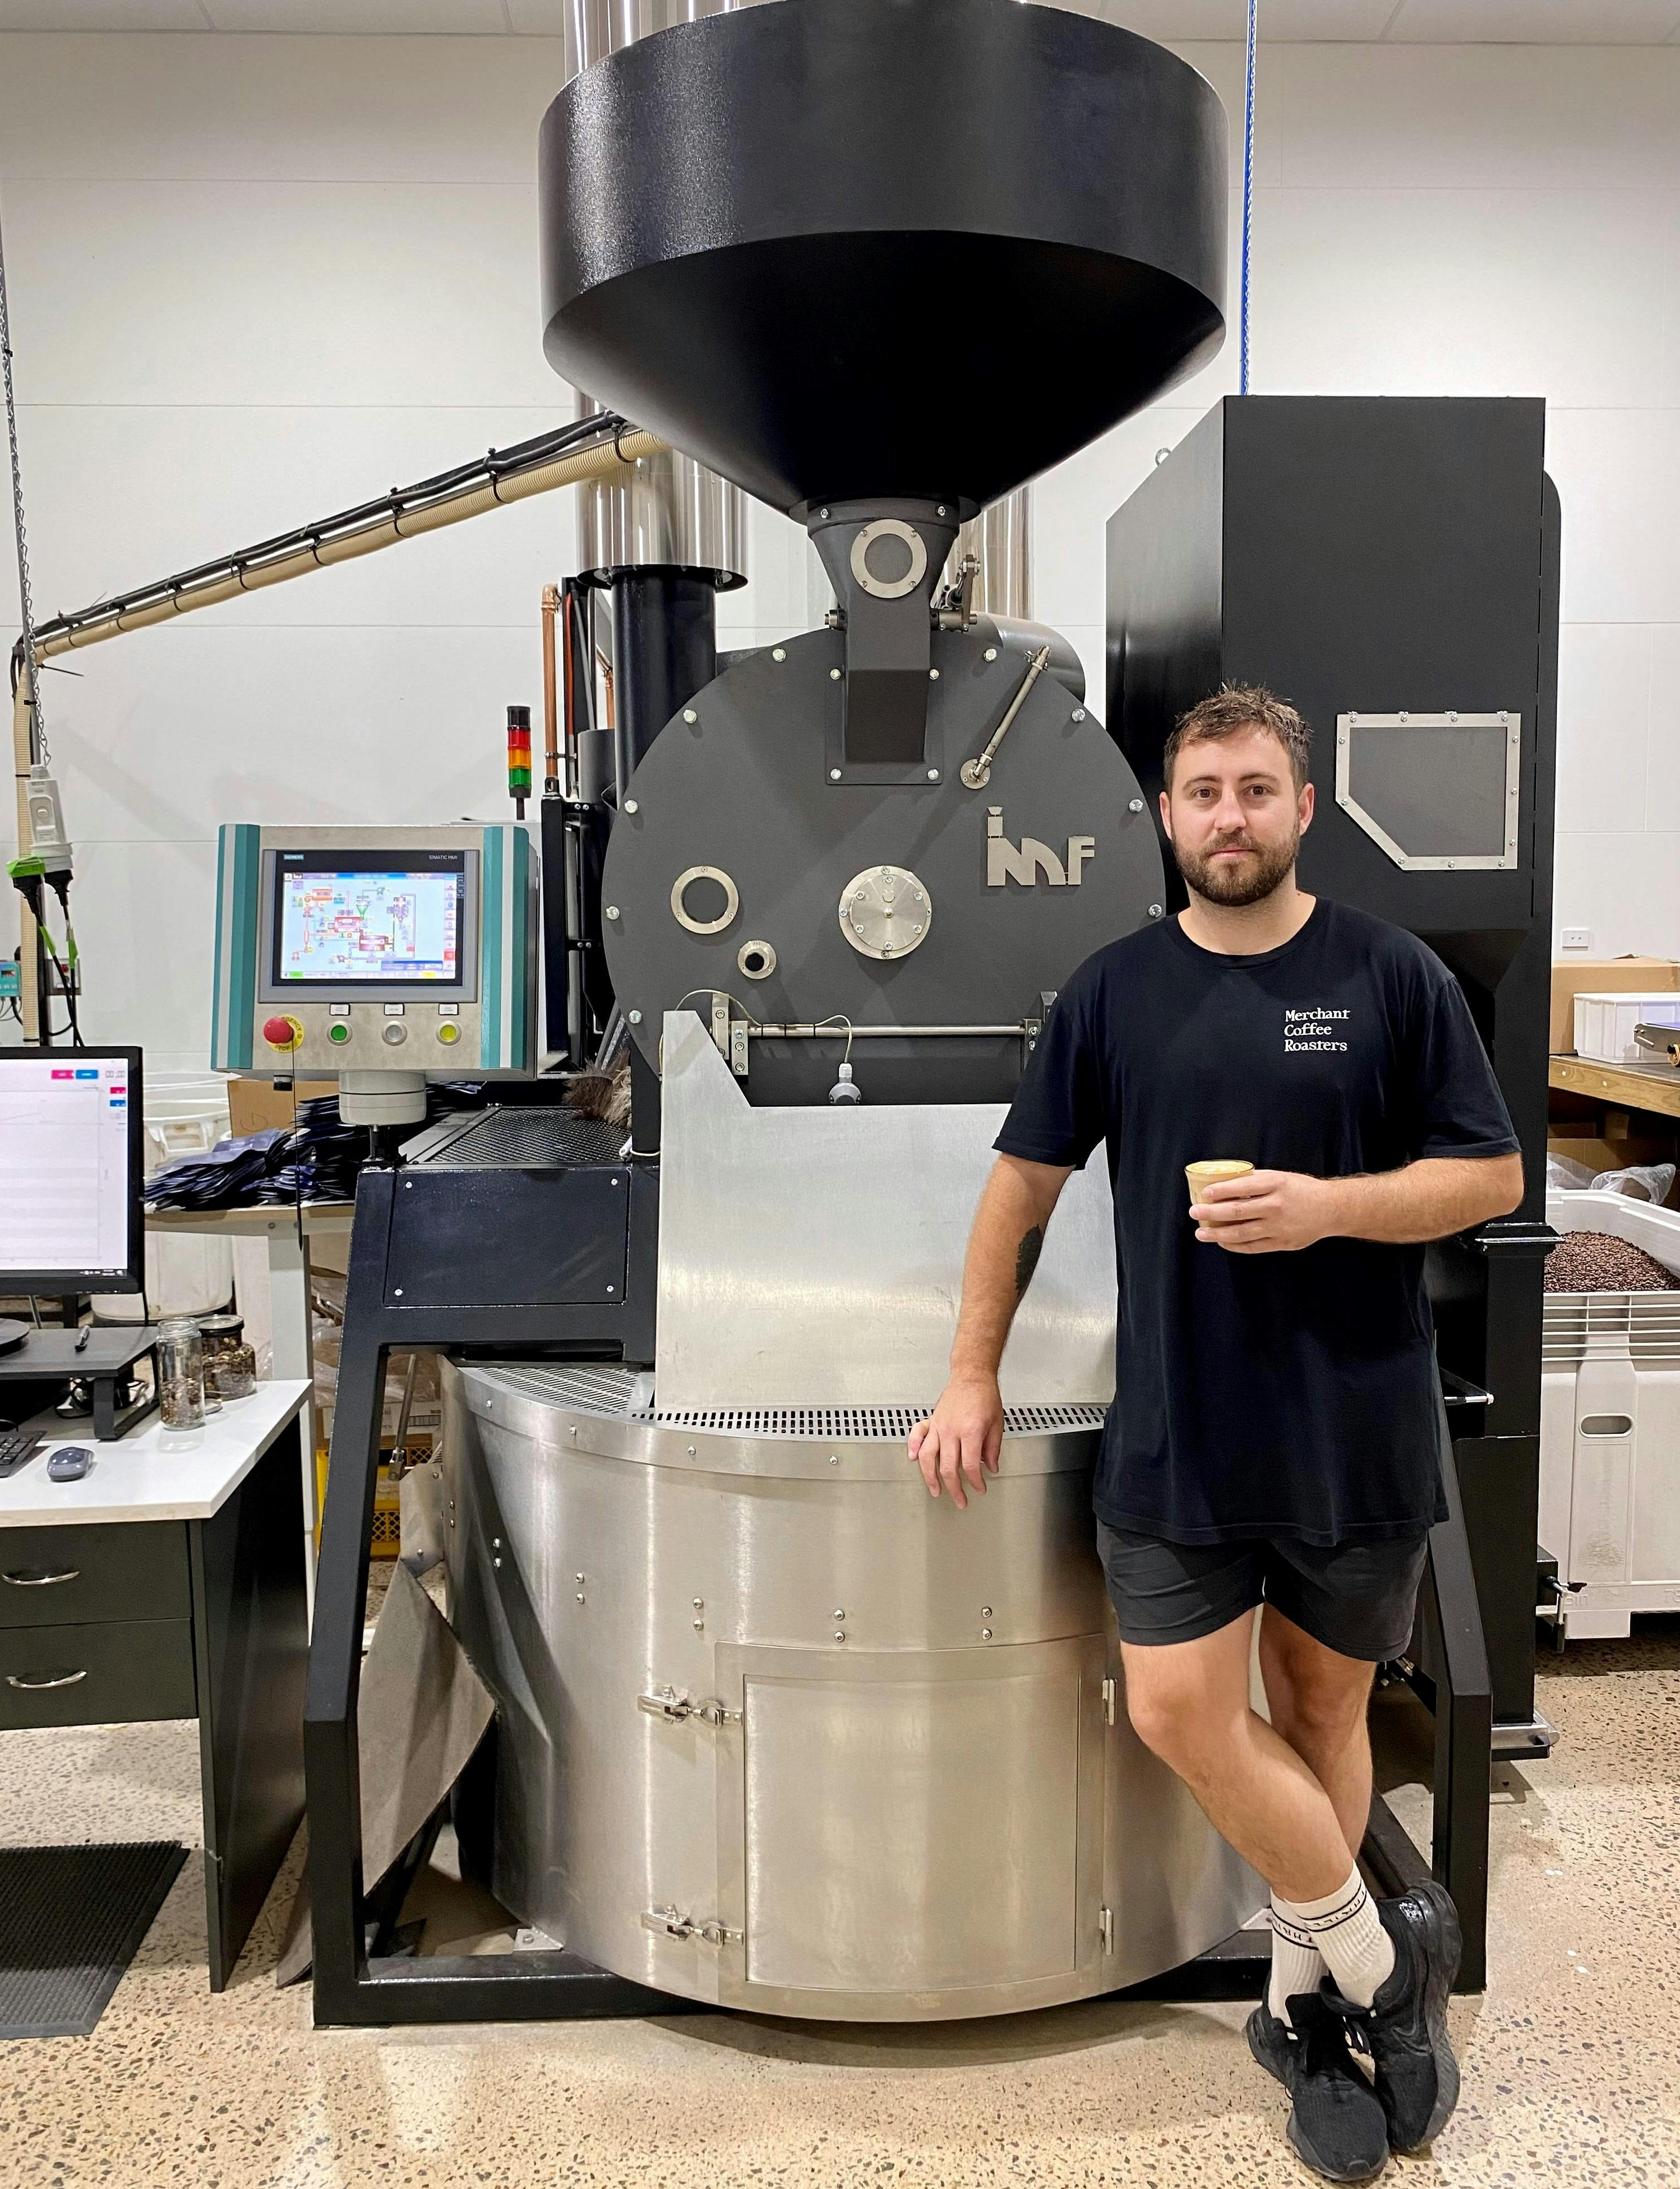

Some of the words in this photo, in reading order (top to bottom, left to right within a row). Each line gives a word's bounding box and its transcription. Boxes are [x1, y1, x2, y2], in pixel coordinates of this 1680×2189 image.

[455, 875, 464, 897] TOUCH
[1285, 1008, 1350, 1022] Merchant
[1284, 1023, 1332, 1037] Coffee
[1284, 1040, 1347, 1052] Roasters
